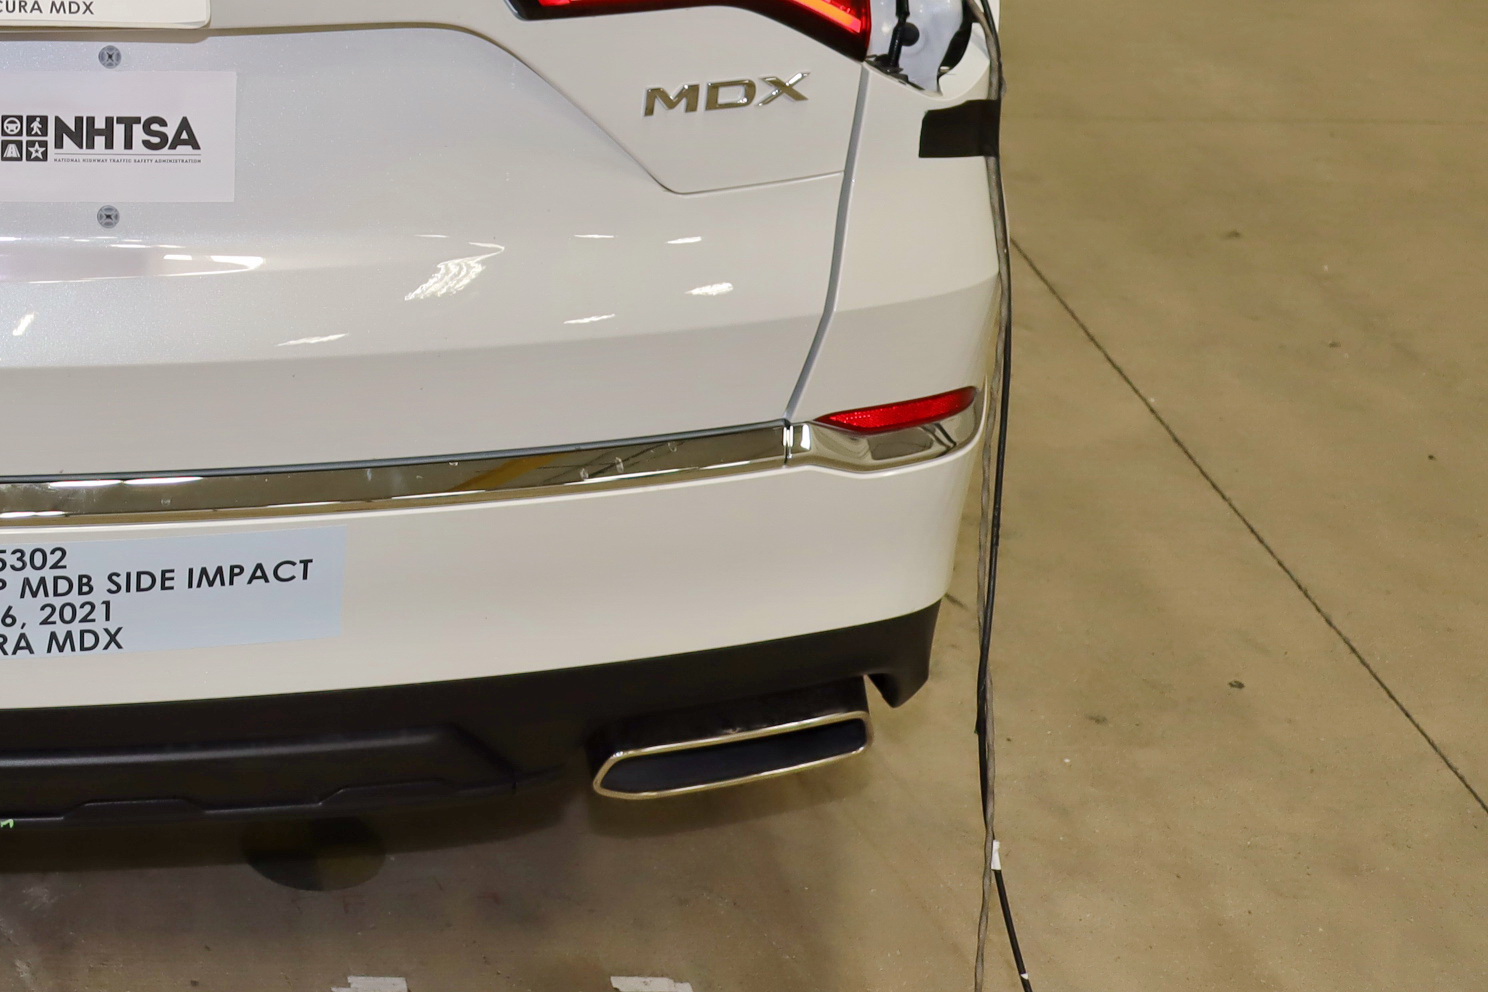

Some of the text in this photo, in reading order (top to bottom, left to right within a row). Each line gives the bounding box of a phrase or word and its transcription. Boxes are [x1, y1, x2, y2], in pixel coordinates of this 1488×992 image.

[50, 1, 93, 14] MDX
[644, 72, 811, 117] MDX
[54, 116, 201, 151] NHTSA
[20, 574, 93, 599] MDB
[107, 569, 174, 594] SIDE
[188, 559, 313, 589] IMPACT
[1, 605, 26, 629] 6,
[39, 600, 110, 625] 2021
[47, 627, 123, 653] MDX
